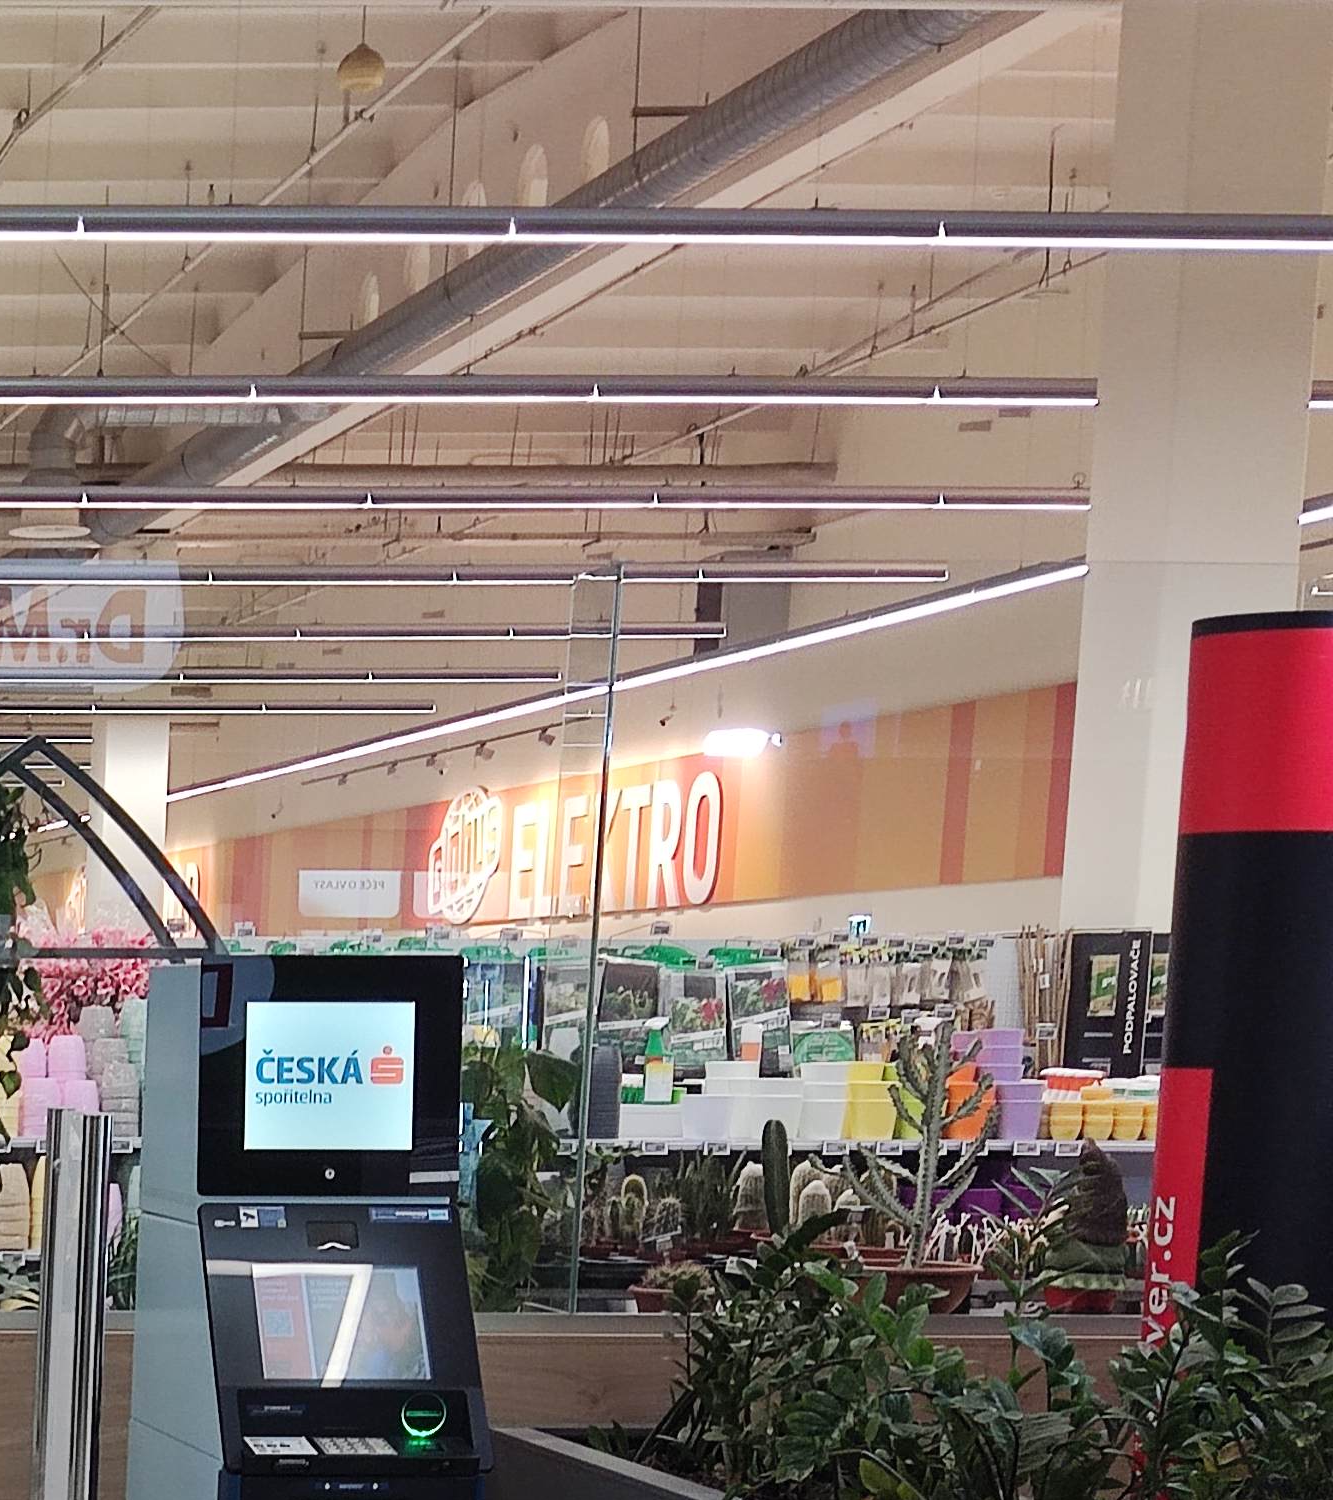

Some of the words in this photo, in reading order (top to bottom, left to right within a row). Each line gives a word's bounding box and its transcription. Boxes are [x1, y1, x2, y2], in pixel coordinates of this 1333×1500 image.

[509, 770, 724, 920] ELEKTRO
[1123, 939, 1141, 1054] PODPALOVAČE
[255, 1049, 364, 1085] ČESKÁ
[255, 1089, 332, 1107] spořitelna
